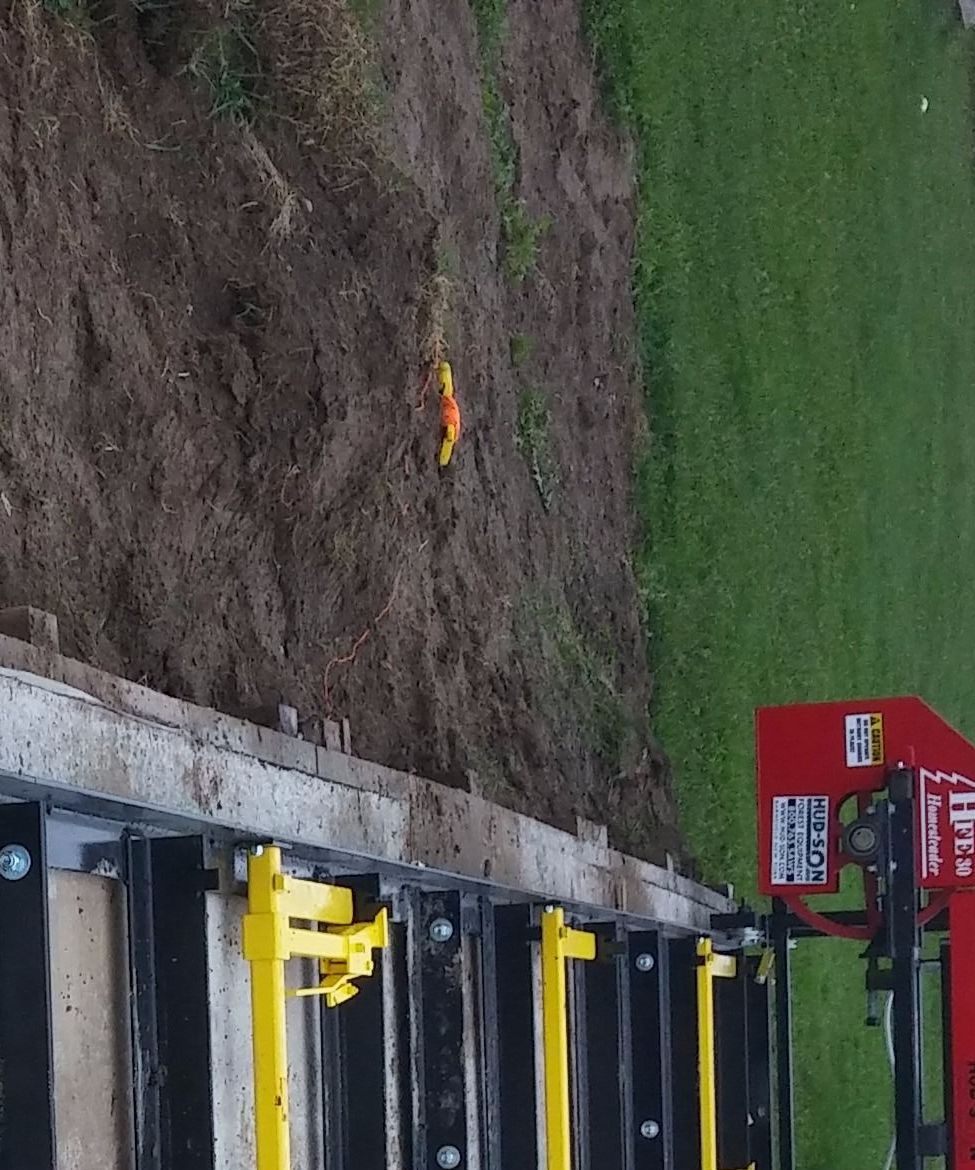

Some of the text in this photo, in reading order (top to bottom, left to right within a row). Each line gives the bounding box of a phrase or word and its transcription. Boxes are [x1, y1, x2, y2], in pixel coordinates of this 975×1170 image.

[871, 728, 881, 761] CAUTION
[796, 798, 805, 881] FOREST EQUIPMENT
[810, 798, 826, 882] HUD-SON
[927, 793, 943, 876] Homesteader
